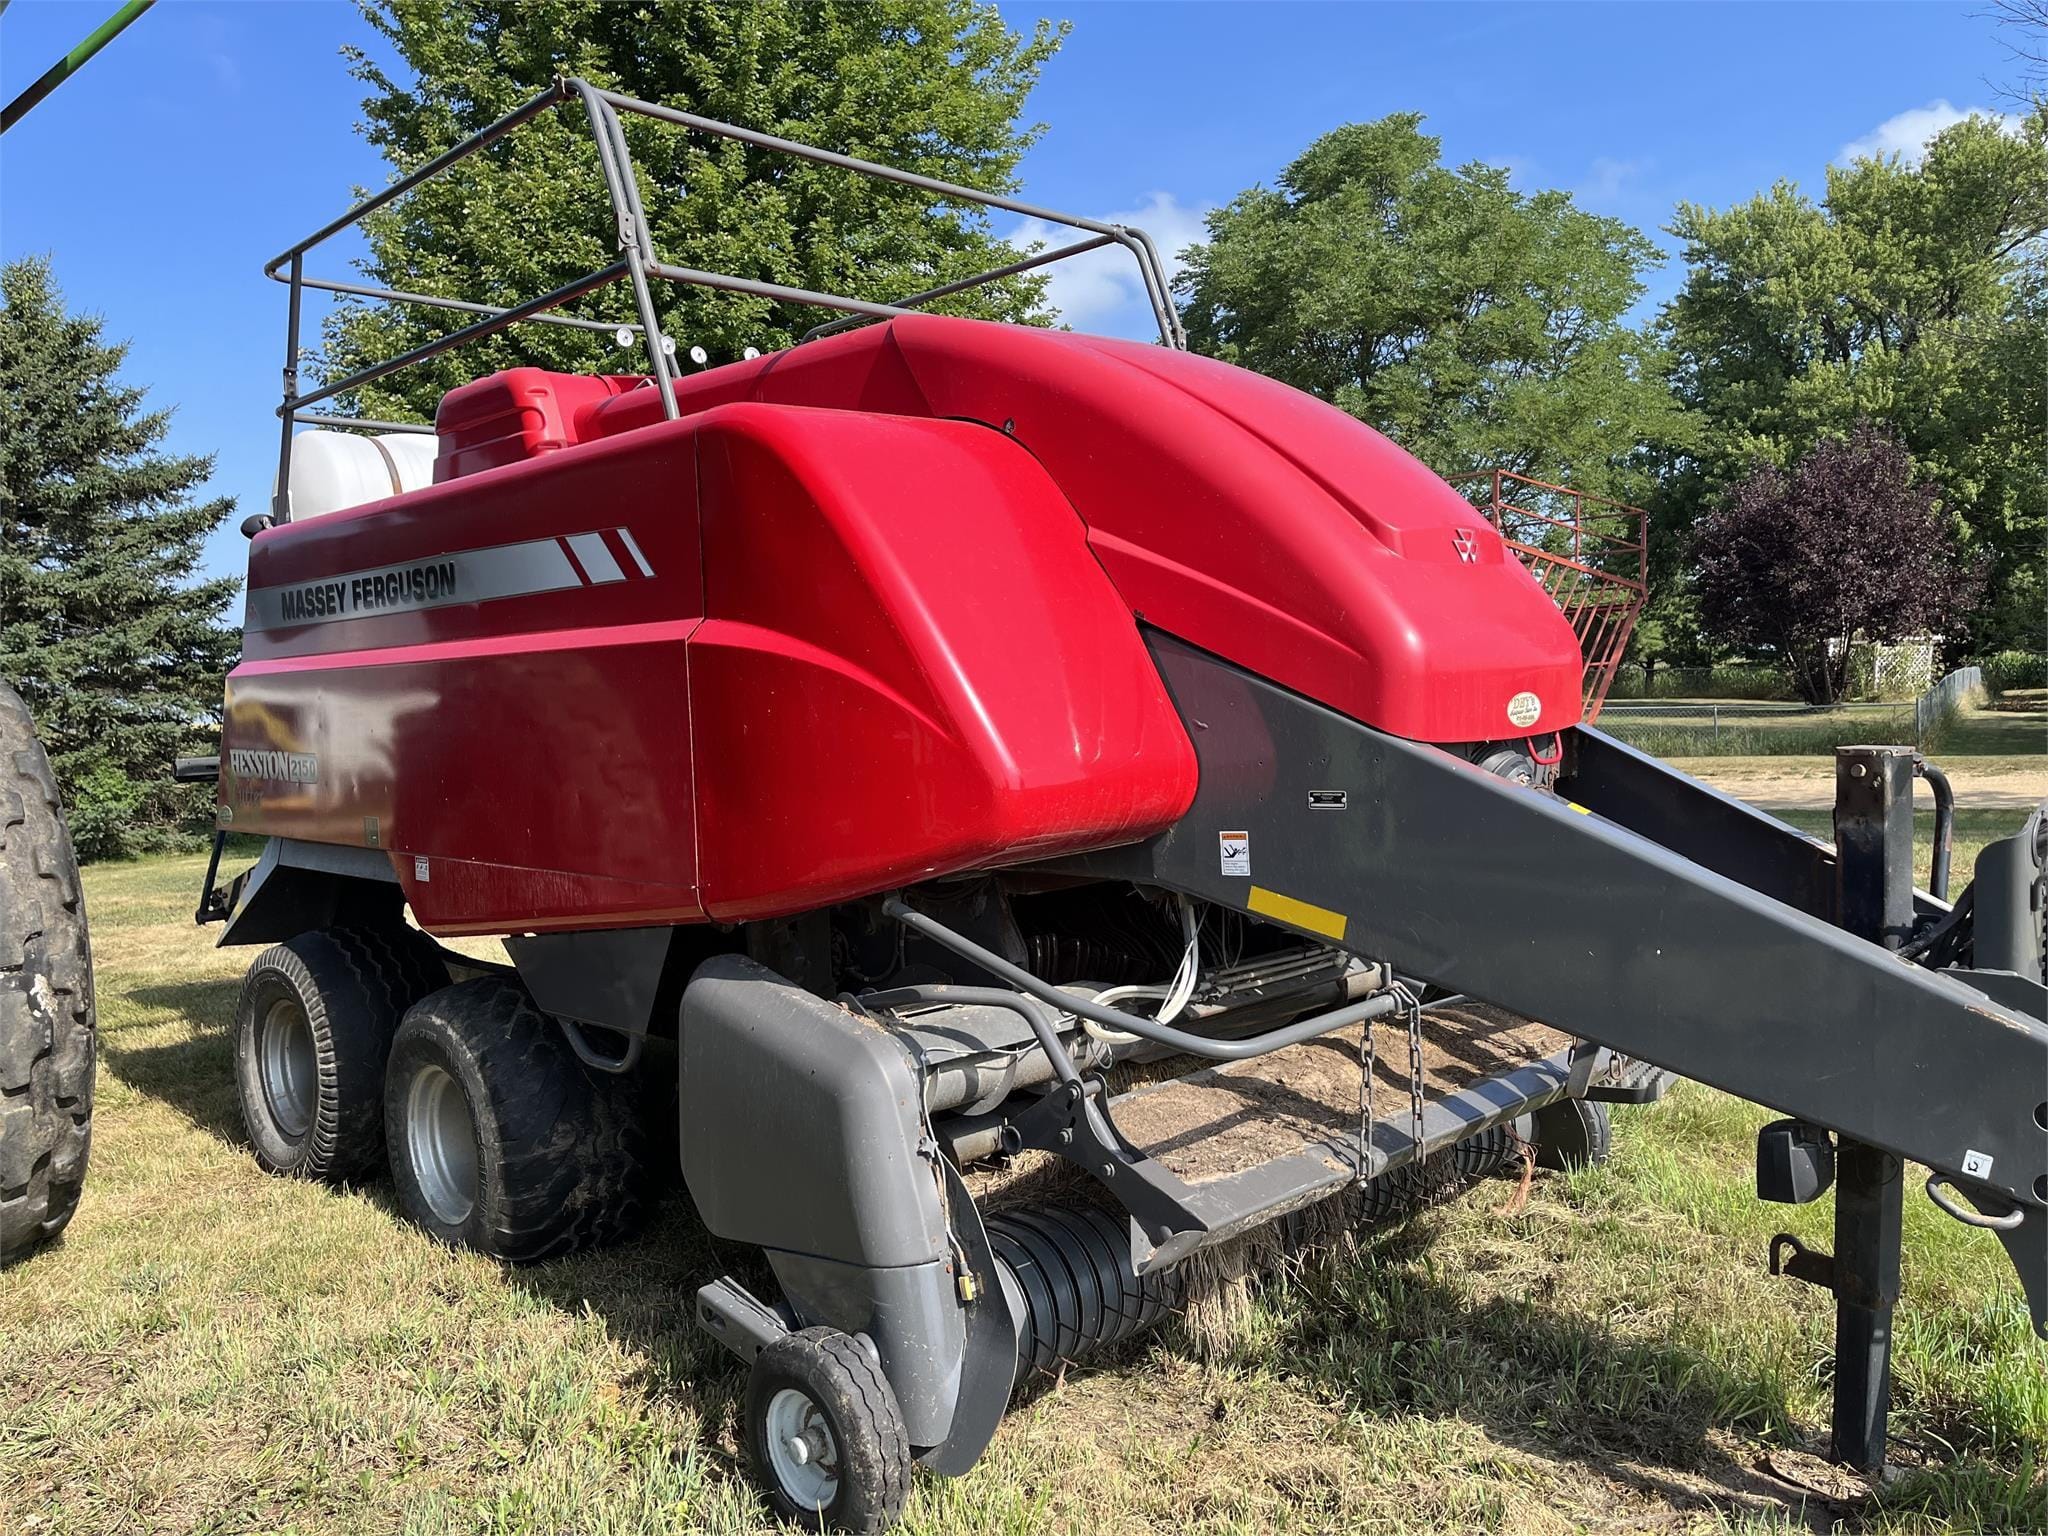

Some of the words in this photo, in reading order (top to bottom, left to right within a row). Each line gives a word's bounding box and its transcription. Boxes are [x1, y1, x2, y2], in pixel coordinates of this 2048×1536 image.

[281, 581, 346, 621] MASSEY
[352, 562, 456, 611] FERGUSON
[229, 749, 289, 781] HESSTON
[291, 759, 316, 778] 2150
